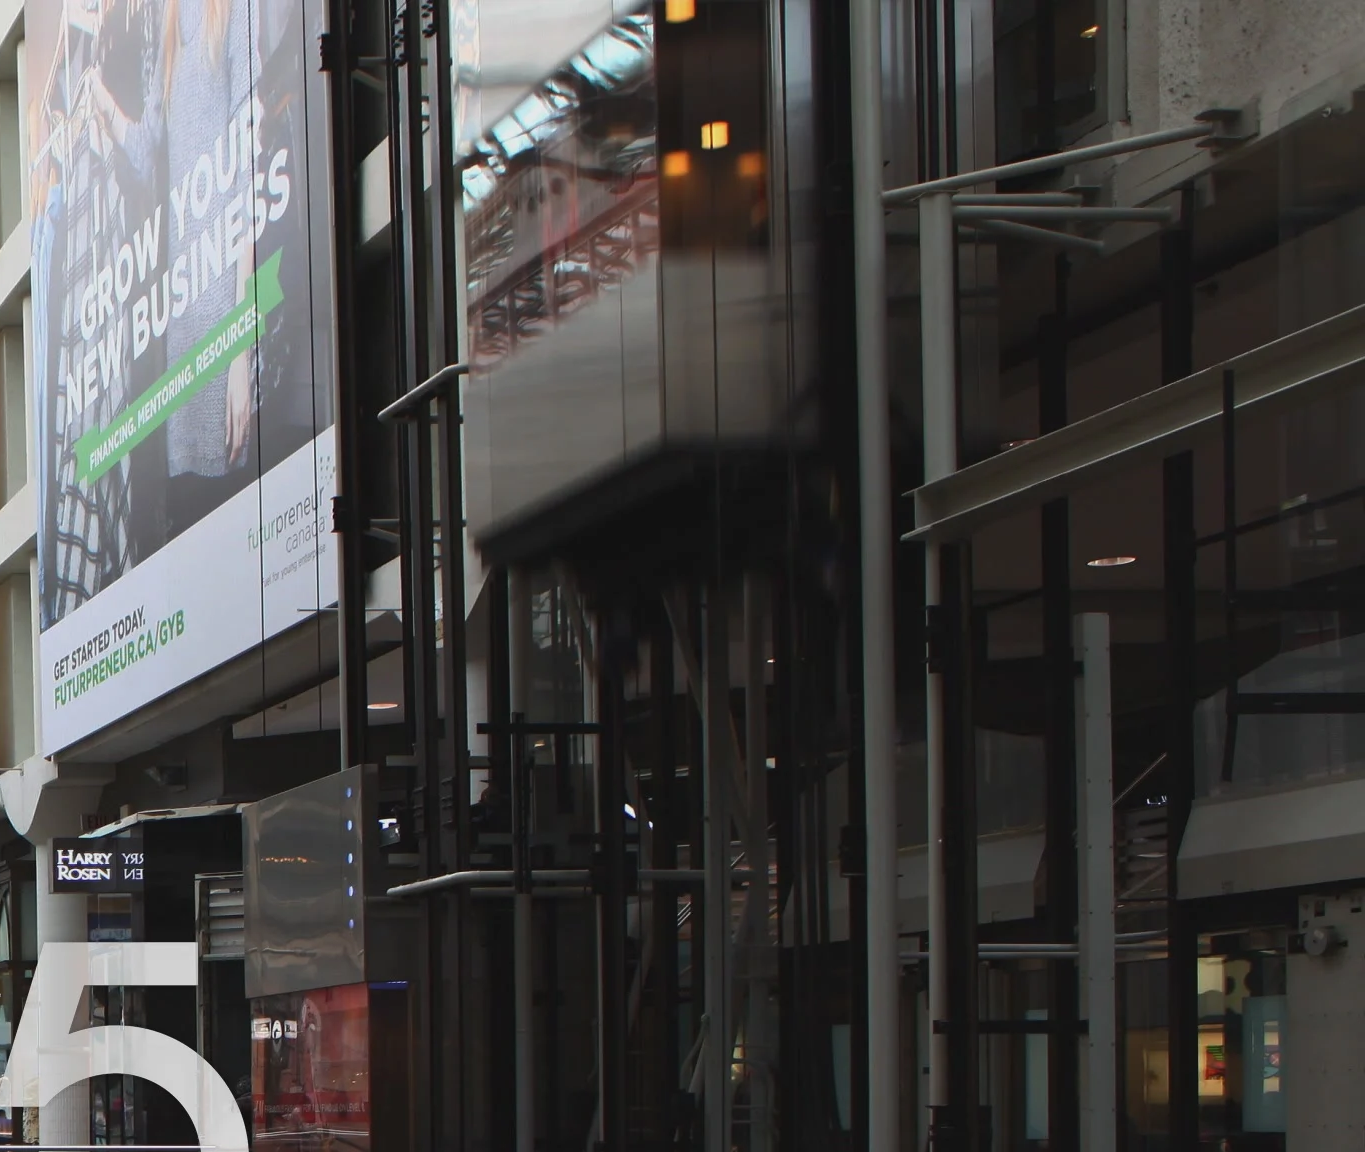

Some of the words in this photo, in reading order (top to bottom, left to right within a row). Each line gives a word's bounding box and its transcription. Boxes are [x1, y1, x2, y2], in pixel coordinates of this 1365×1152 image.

[81, 203, 162, 340] GROW
[169, 102, 263, 241] YOUR
[66, 318, 124, 422] NEW
[132, 149, 290, 360] BUSINESS
[89, 420, 137, 472] FINANCING.
[137, 363, 194, 429] MENTORING.
[247, 485, 325, 553] futurpreneur
[54, 655, 70, 681] GET
[71, 629, 110, 670] STARTED
[112, 605, 146, 643] TODAY.
[54, 610, 185, 709] FUTURPRENEUR.CA/GYB
[57, 849, 113, 865] HARRY
[57, 865, 111, 881] ROSEN
